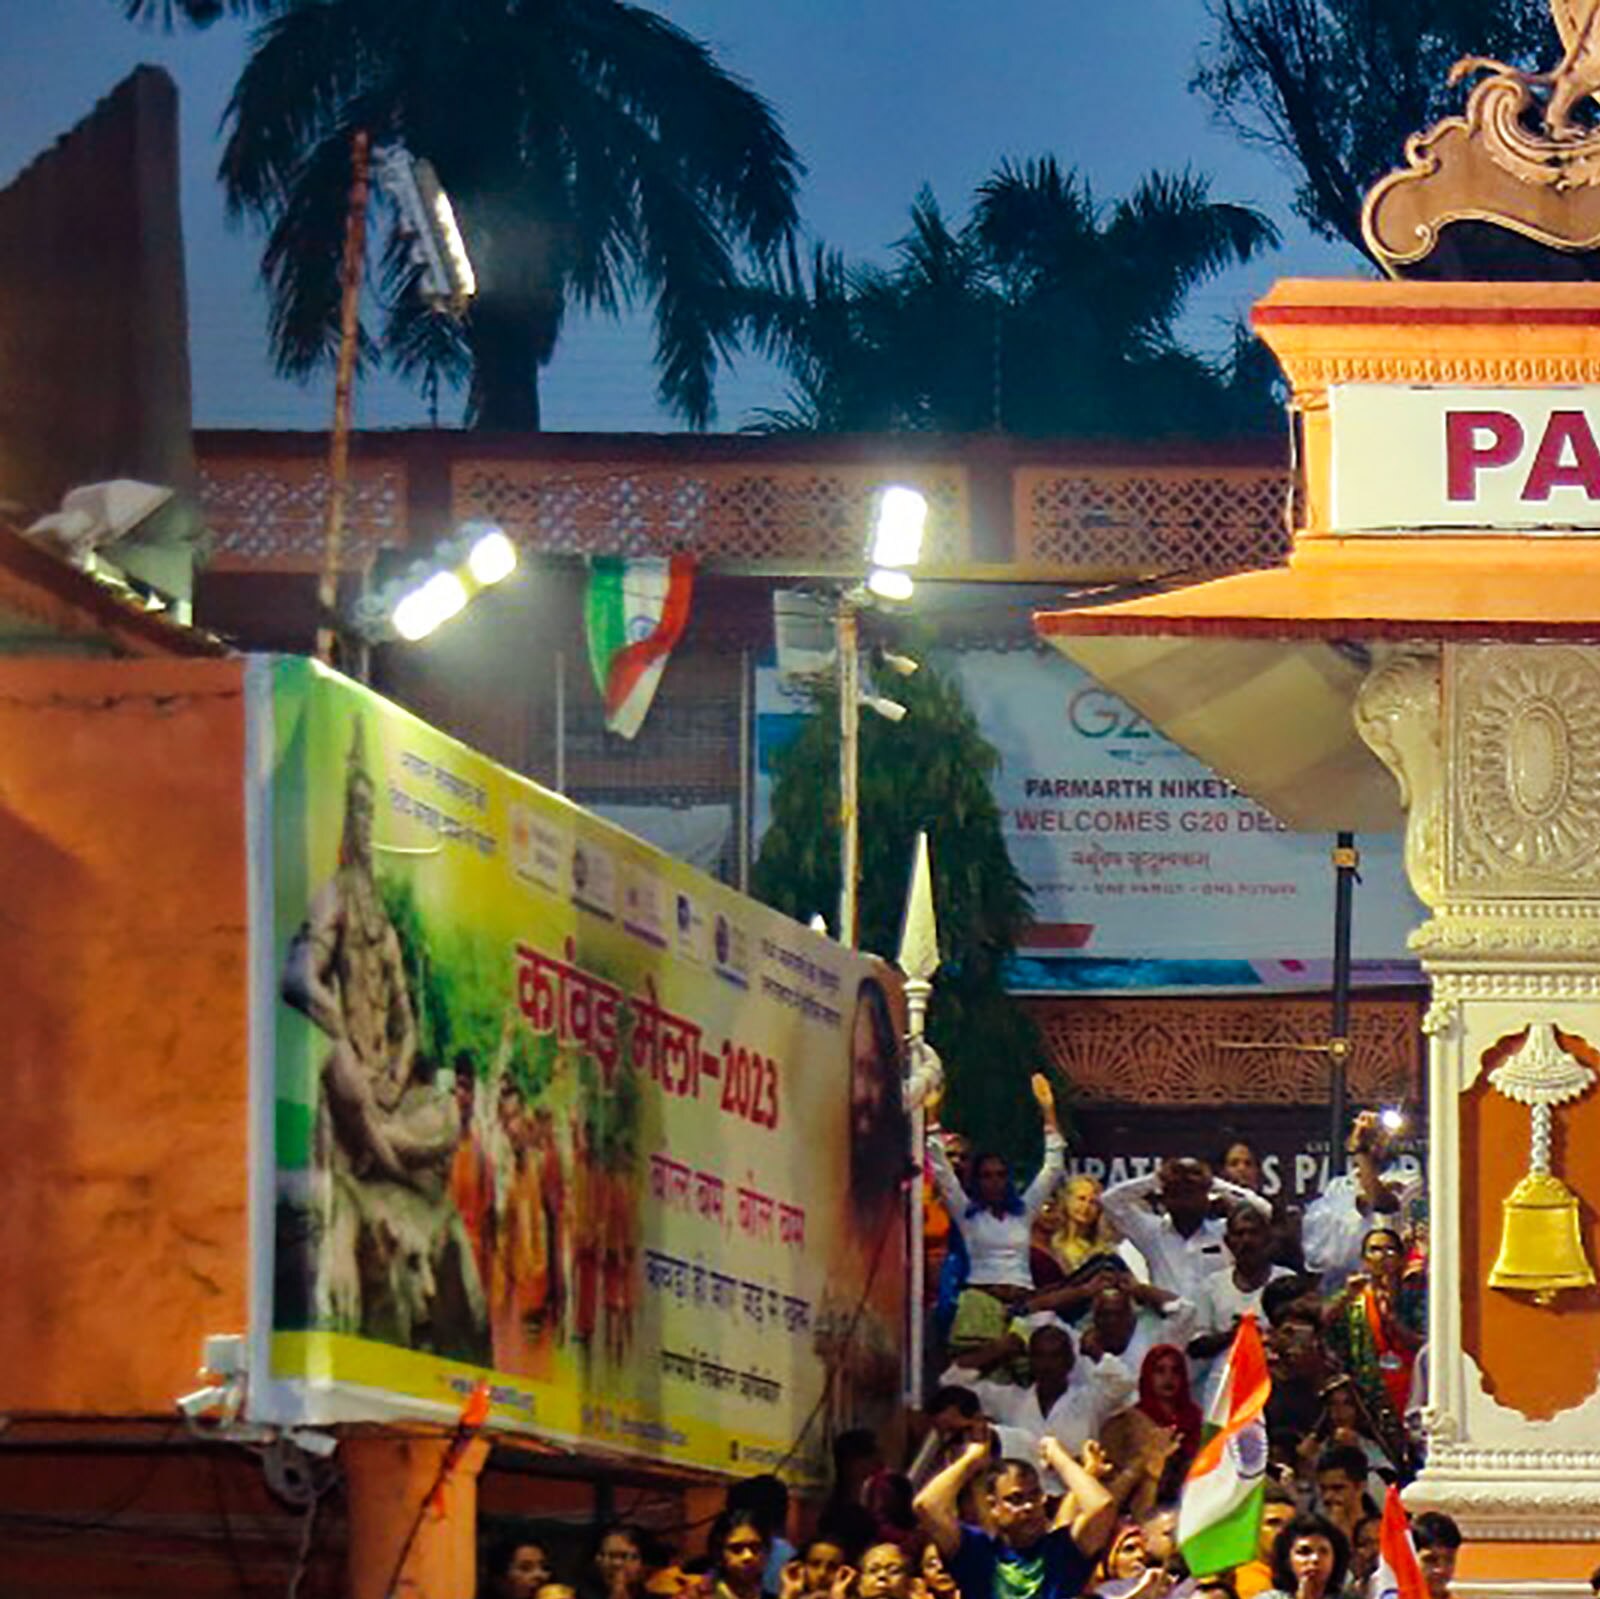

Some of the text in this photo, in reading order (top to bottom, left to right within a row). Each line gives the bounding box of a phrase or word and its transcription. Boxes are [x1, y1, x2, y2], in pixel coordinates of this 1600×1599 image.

[1025, 778, 1152, 799] PARMARTH
[1015, 811, 1171, 833] WELCOMES
[1180, 811, 1229, 833] G20
